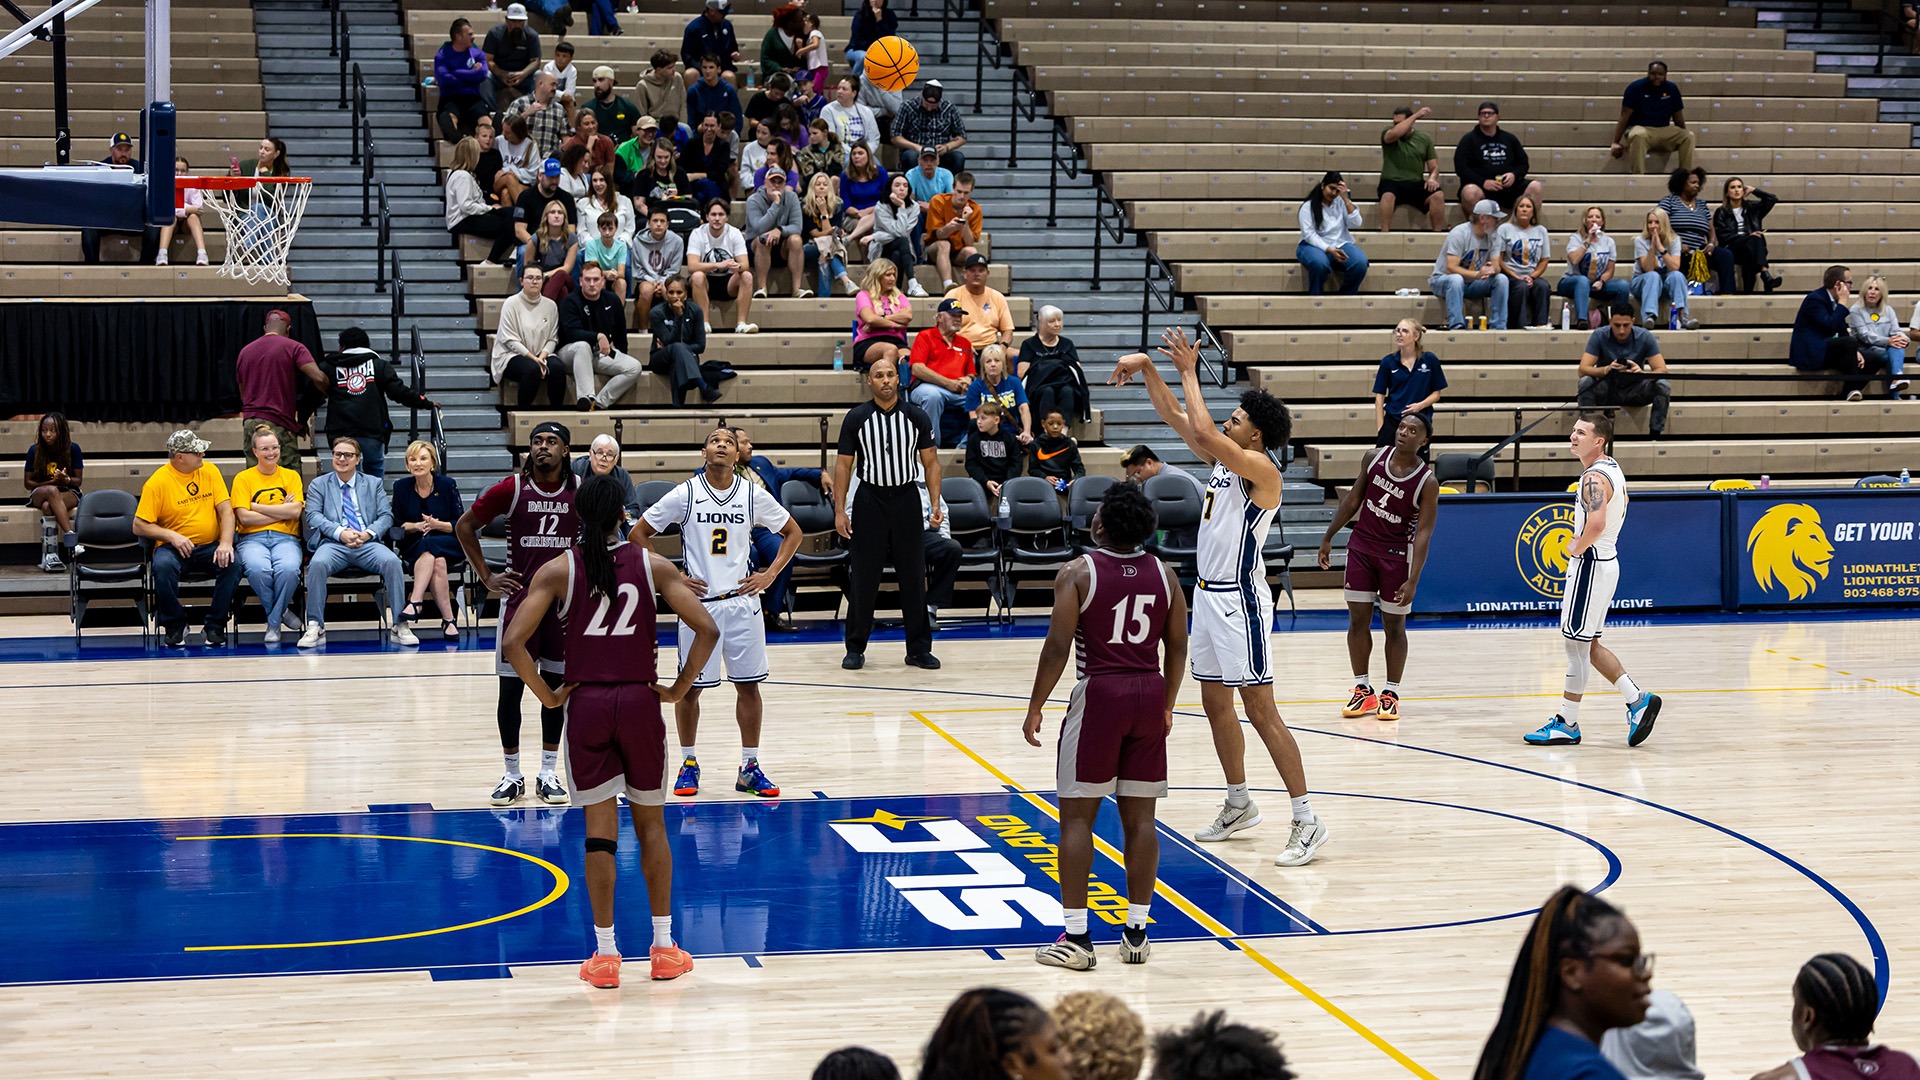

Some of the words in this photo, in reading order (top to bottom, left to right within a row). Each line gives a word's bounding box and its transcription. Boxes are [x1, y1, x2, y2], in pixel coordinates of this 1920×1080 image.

[1372, 474, 1405, 499] DALLAS
[528, 500, 570, 514] DALLAS
[1378, 492, 1391, 509] 4
[536, 514, 560, 536] 12
[696, 512, 745, 524] LIONS
[519, 535, 572, 548] CHRISTIAN
[1521, 515, 1549, 546] ALL
[1834, 522, 1867, 542] GET
[1870, 521, 1915, 541] YOUR
[710, 527, 728, 557] 2
[1531, 572, 1564, 594] ALL
[1843, 575, 1920, 586] LIONTICKET
[583, 583, 638, 636] 22
[1106, 594, 1156, 645] 15
